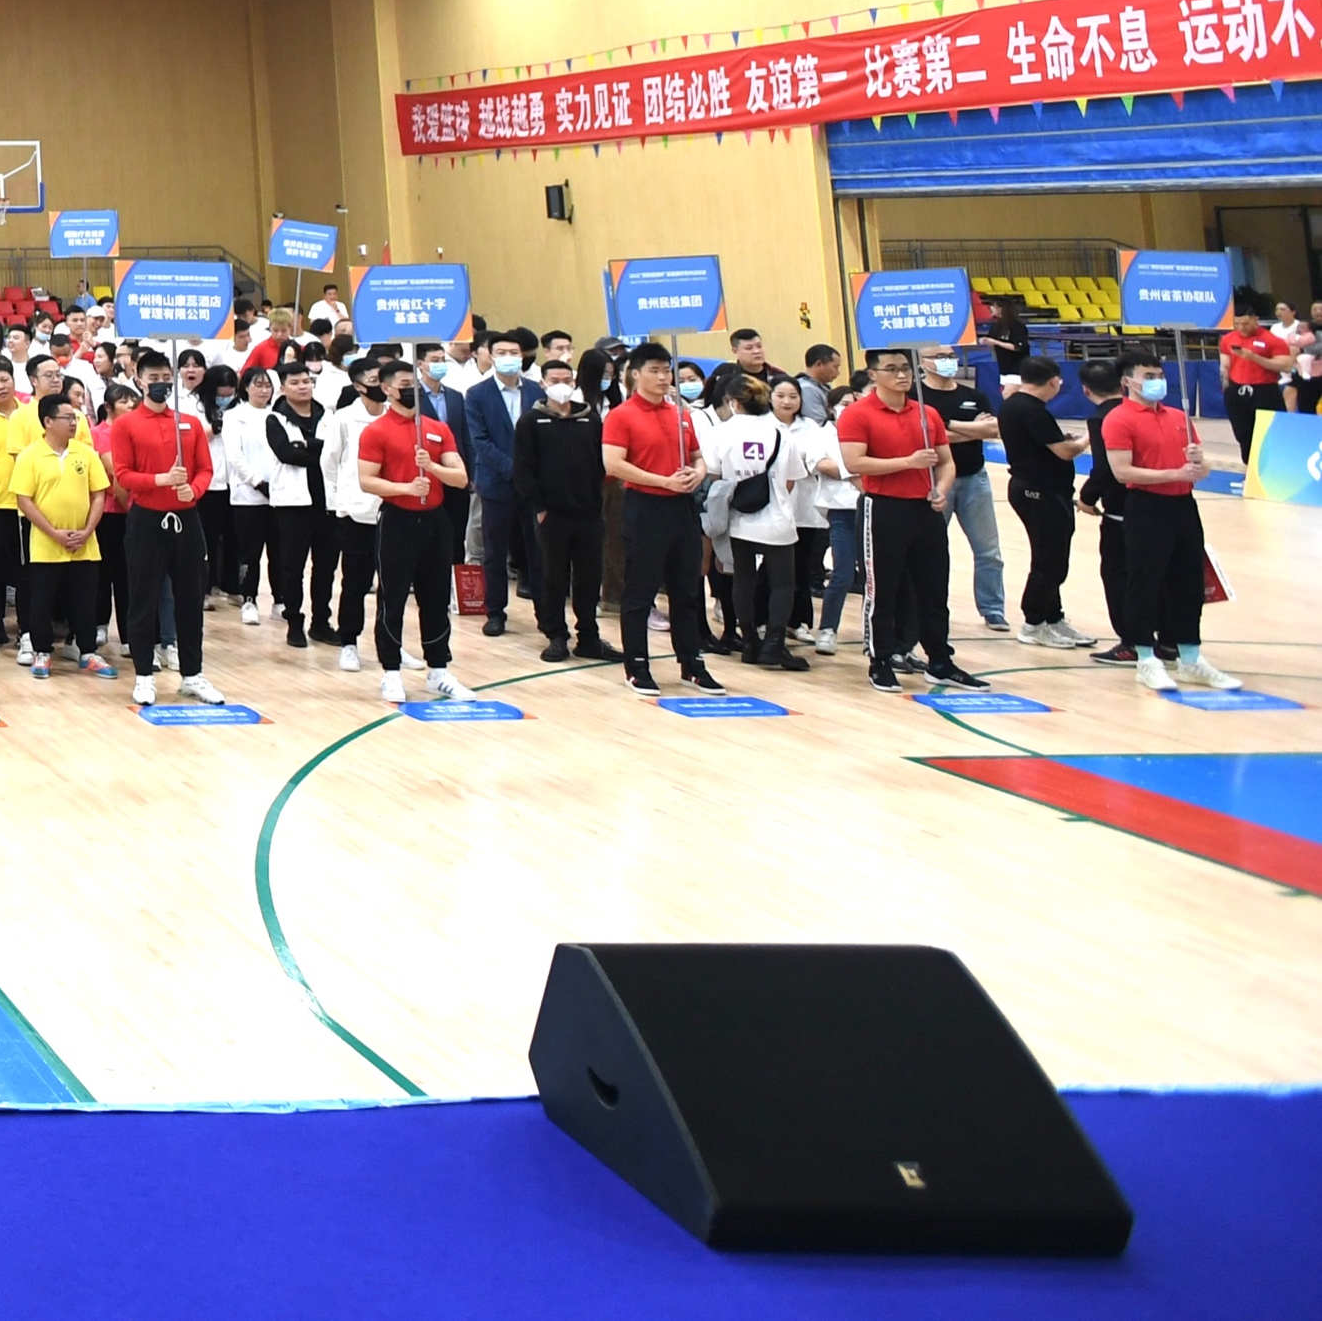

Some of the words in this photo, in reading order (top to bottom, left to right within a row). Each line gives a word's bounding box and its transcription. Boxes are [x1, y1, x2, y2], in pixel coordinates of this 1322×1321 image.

[411, 100, 470, 144] 我爱篮球
[477, 91, 546, 141] 越战越勇
[556, 81, 632, 133] 实力见证
[642, 65, 732, 126] 团结必胜
[744, 53, 848, 116] 友谊第一
[863, 33, 988, 100] 比赛第二
[1005, 5, 1158, 85] 生命不息
[637, 294, 704, 311] 贵州民投集团
[1138, 287, 1217, 305] 贵州省茶协联队
[375, 297, 447, 312] 贵州省红十字
[872, 302, 955, 318] 贵州广播电视台
[139, 307, 211, 322] 管理有限公司
[394, 311, 430, 325] 基金会
[879, 315, 951, 330] 大健康事业部
[1024, 489, 1041, 499] EA7
